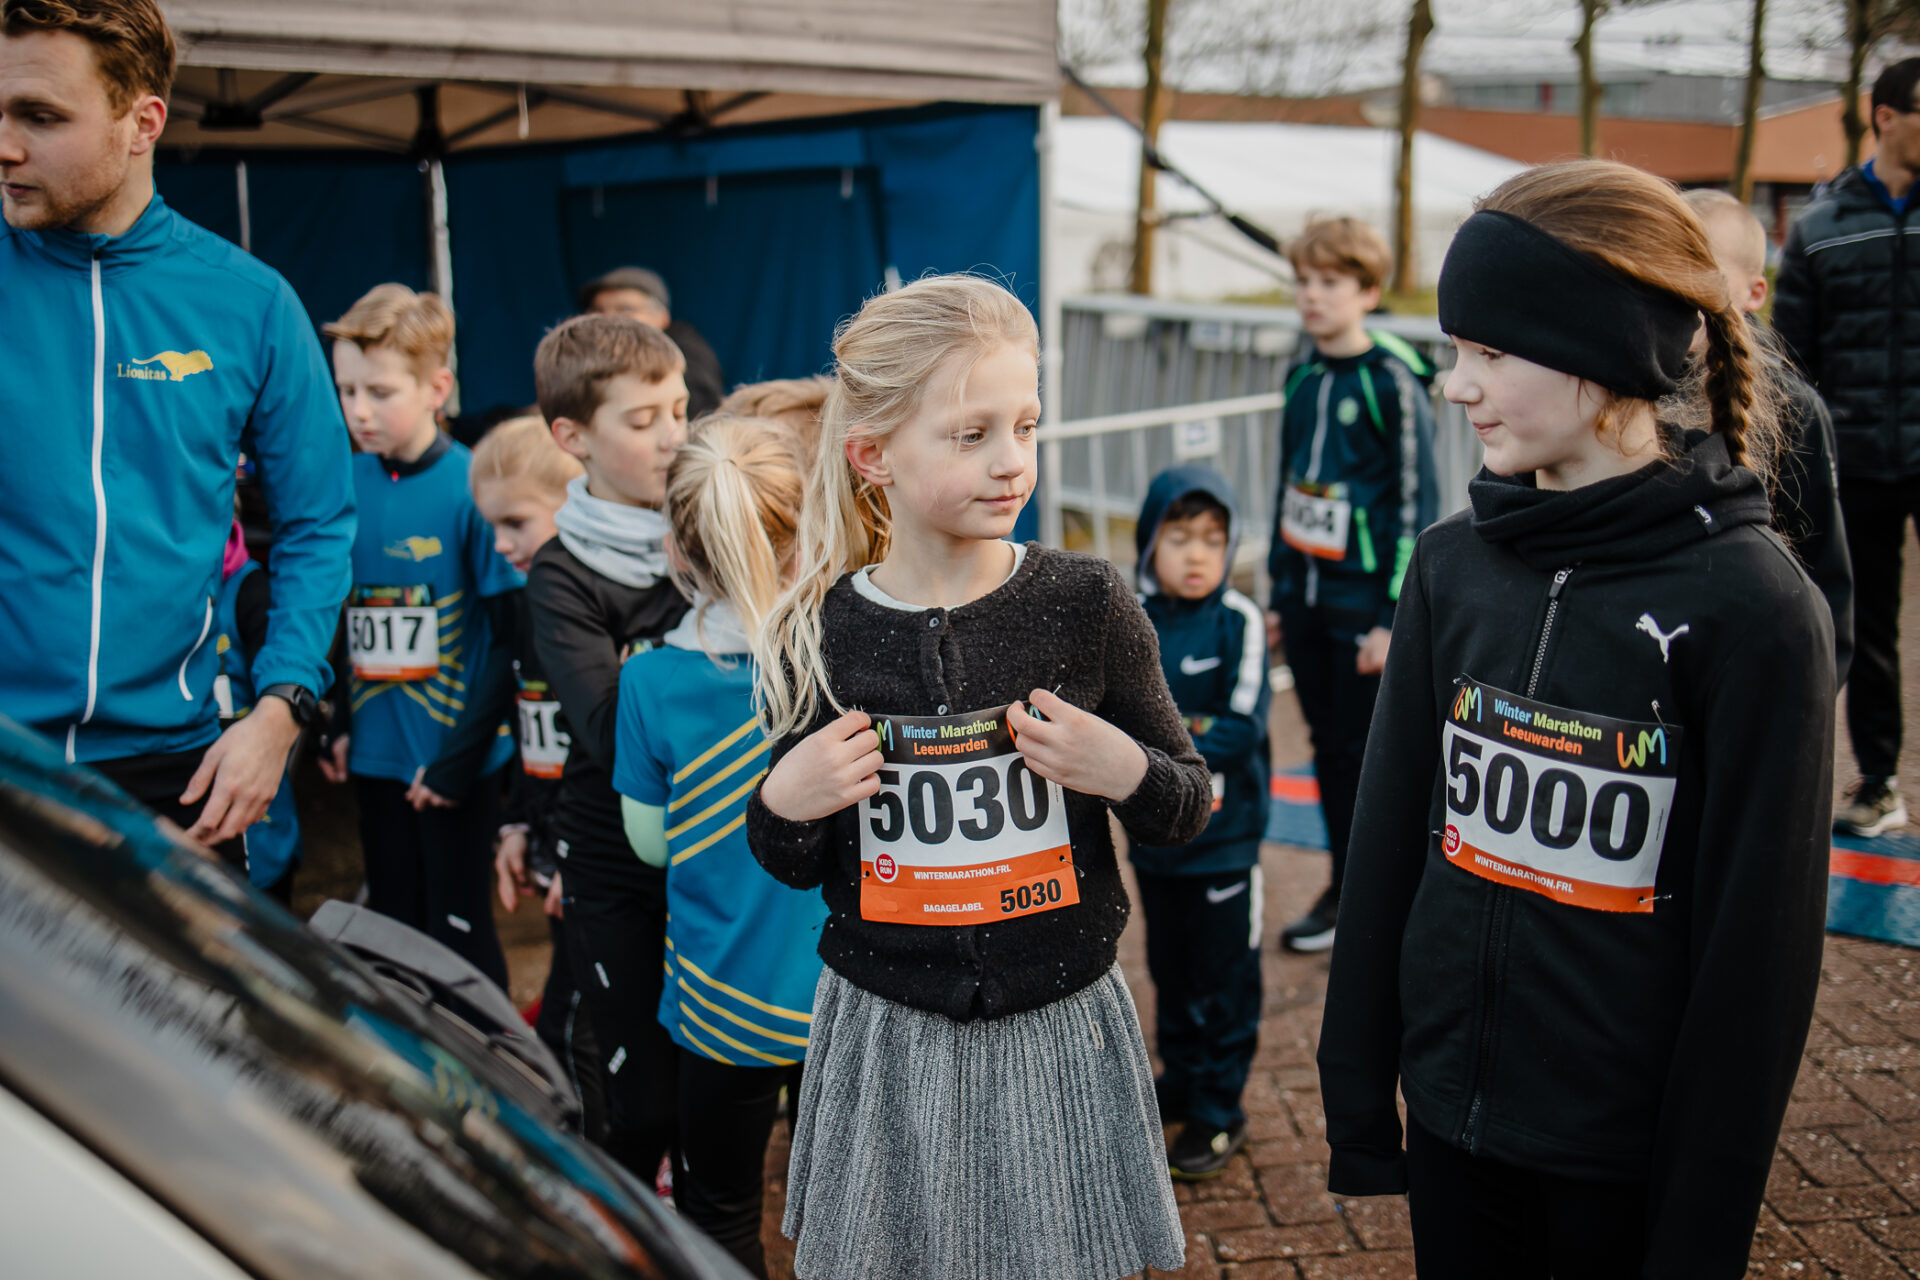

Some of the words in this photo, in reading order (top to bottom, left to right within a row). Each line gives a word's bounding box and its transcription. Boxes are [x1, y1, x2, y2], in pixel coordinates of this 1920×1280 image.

[117, 363, 167, 381] Lionitas
[901, 724, 938, 740] Winter
[939, 718, 998, 739] Marathon
[1494, 698, 1532, 723] Winter
[1533, 712, 1603, 741] Marathon
[913, 738, 989, 756] Leeuwarden
[1503, 721, 1583, 756] Leeuwarden
[869, 756, 1050, 845] 5030
[1447, 732, 1651, 862] 5000
[878, 858, 892, 868] KIDS
[879, 866, 893, 876] RUN
[913, 863, 1012, 881] WINTERMARATHON.FRL
[1474, 853, 1574, 894] WINTERMARATHON.FRL
[1000, 878, 1062, 914] 5030
[923, 902, 984, 913] BAGAGELABEL
